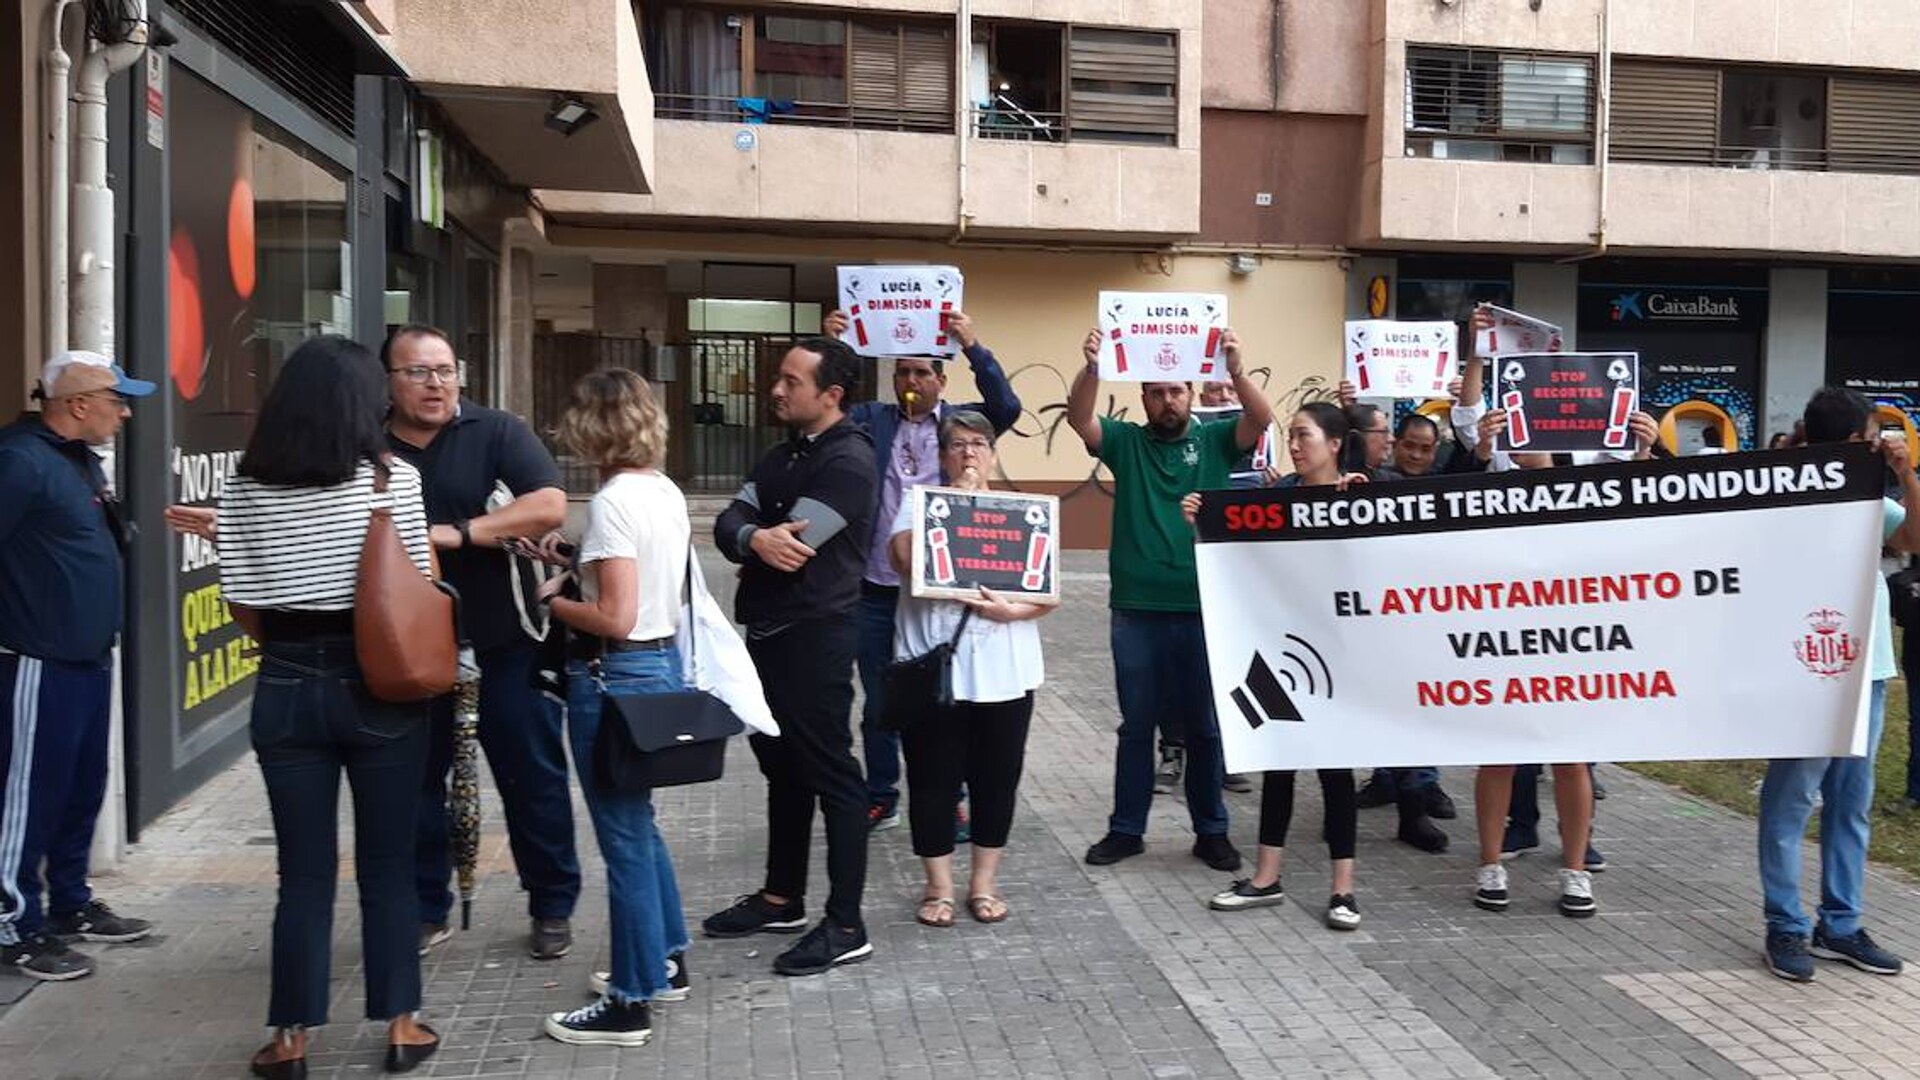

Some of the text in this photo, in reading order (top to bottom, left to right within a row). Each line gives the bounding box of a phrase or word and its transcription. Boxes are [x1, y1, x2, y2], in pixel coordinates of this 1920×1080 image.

[881, 278, 922, 293] LUCÍA
[868, 296, 932, 310] DIMISIÓN
[1648, 294, 1739, 316] CaixaBank
[1147, 304, 1189, 317] LUCÍA
[1131, 321, 1198, 335] DIMISIÓN
[1385, 332, 1421, 343] LUCÍA
[1372, 346, 1429, 358] DIMISIÓN
[1550, 371, 1587, 382] STOP
[1533, 387, 1604, 399] RECORTES
[1559, 403, 1579, 414] DE
[1533, 419, 1606, 431] TERRAZAS
[1223, 461, 1846, 531] SOS RECORTE TERRAZAS HONDURAS
[972, 511, 1007, 525] STOP
[956, 526, 1023, 542] RECORTES
[981, 544, 998, 556] DE
[956, 557, 1025, 573] TERRAZAS
[1334, 567, 1741, 617] EL AYUNTAMIENTO DE
[1448, 623, 1633, 659] VALENCIA
[1417, 670, 1676, 707] NOS ARRUINA
